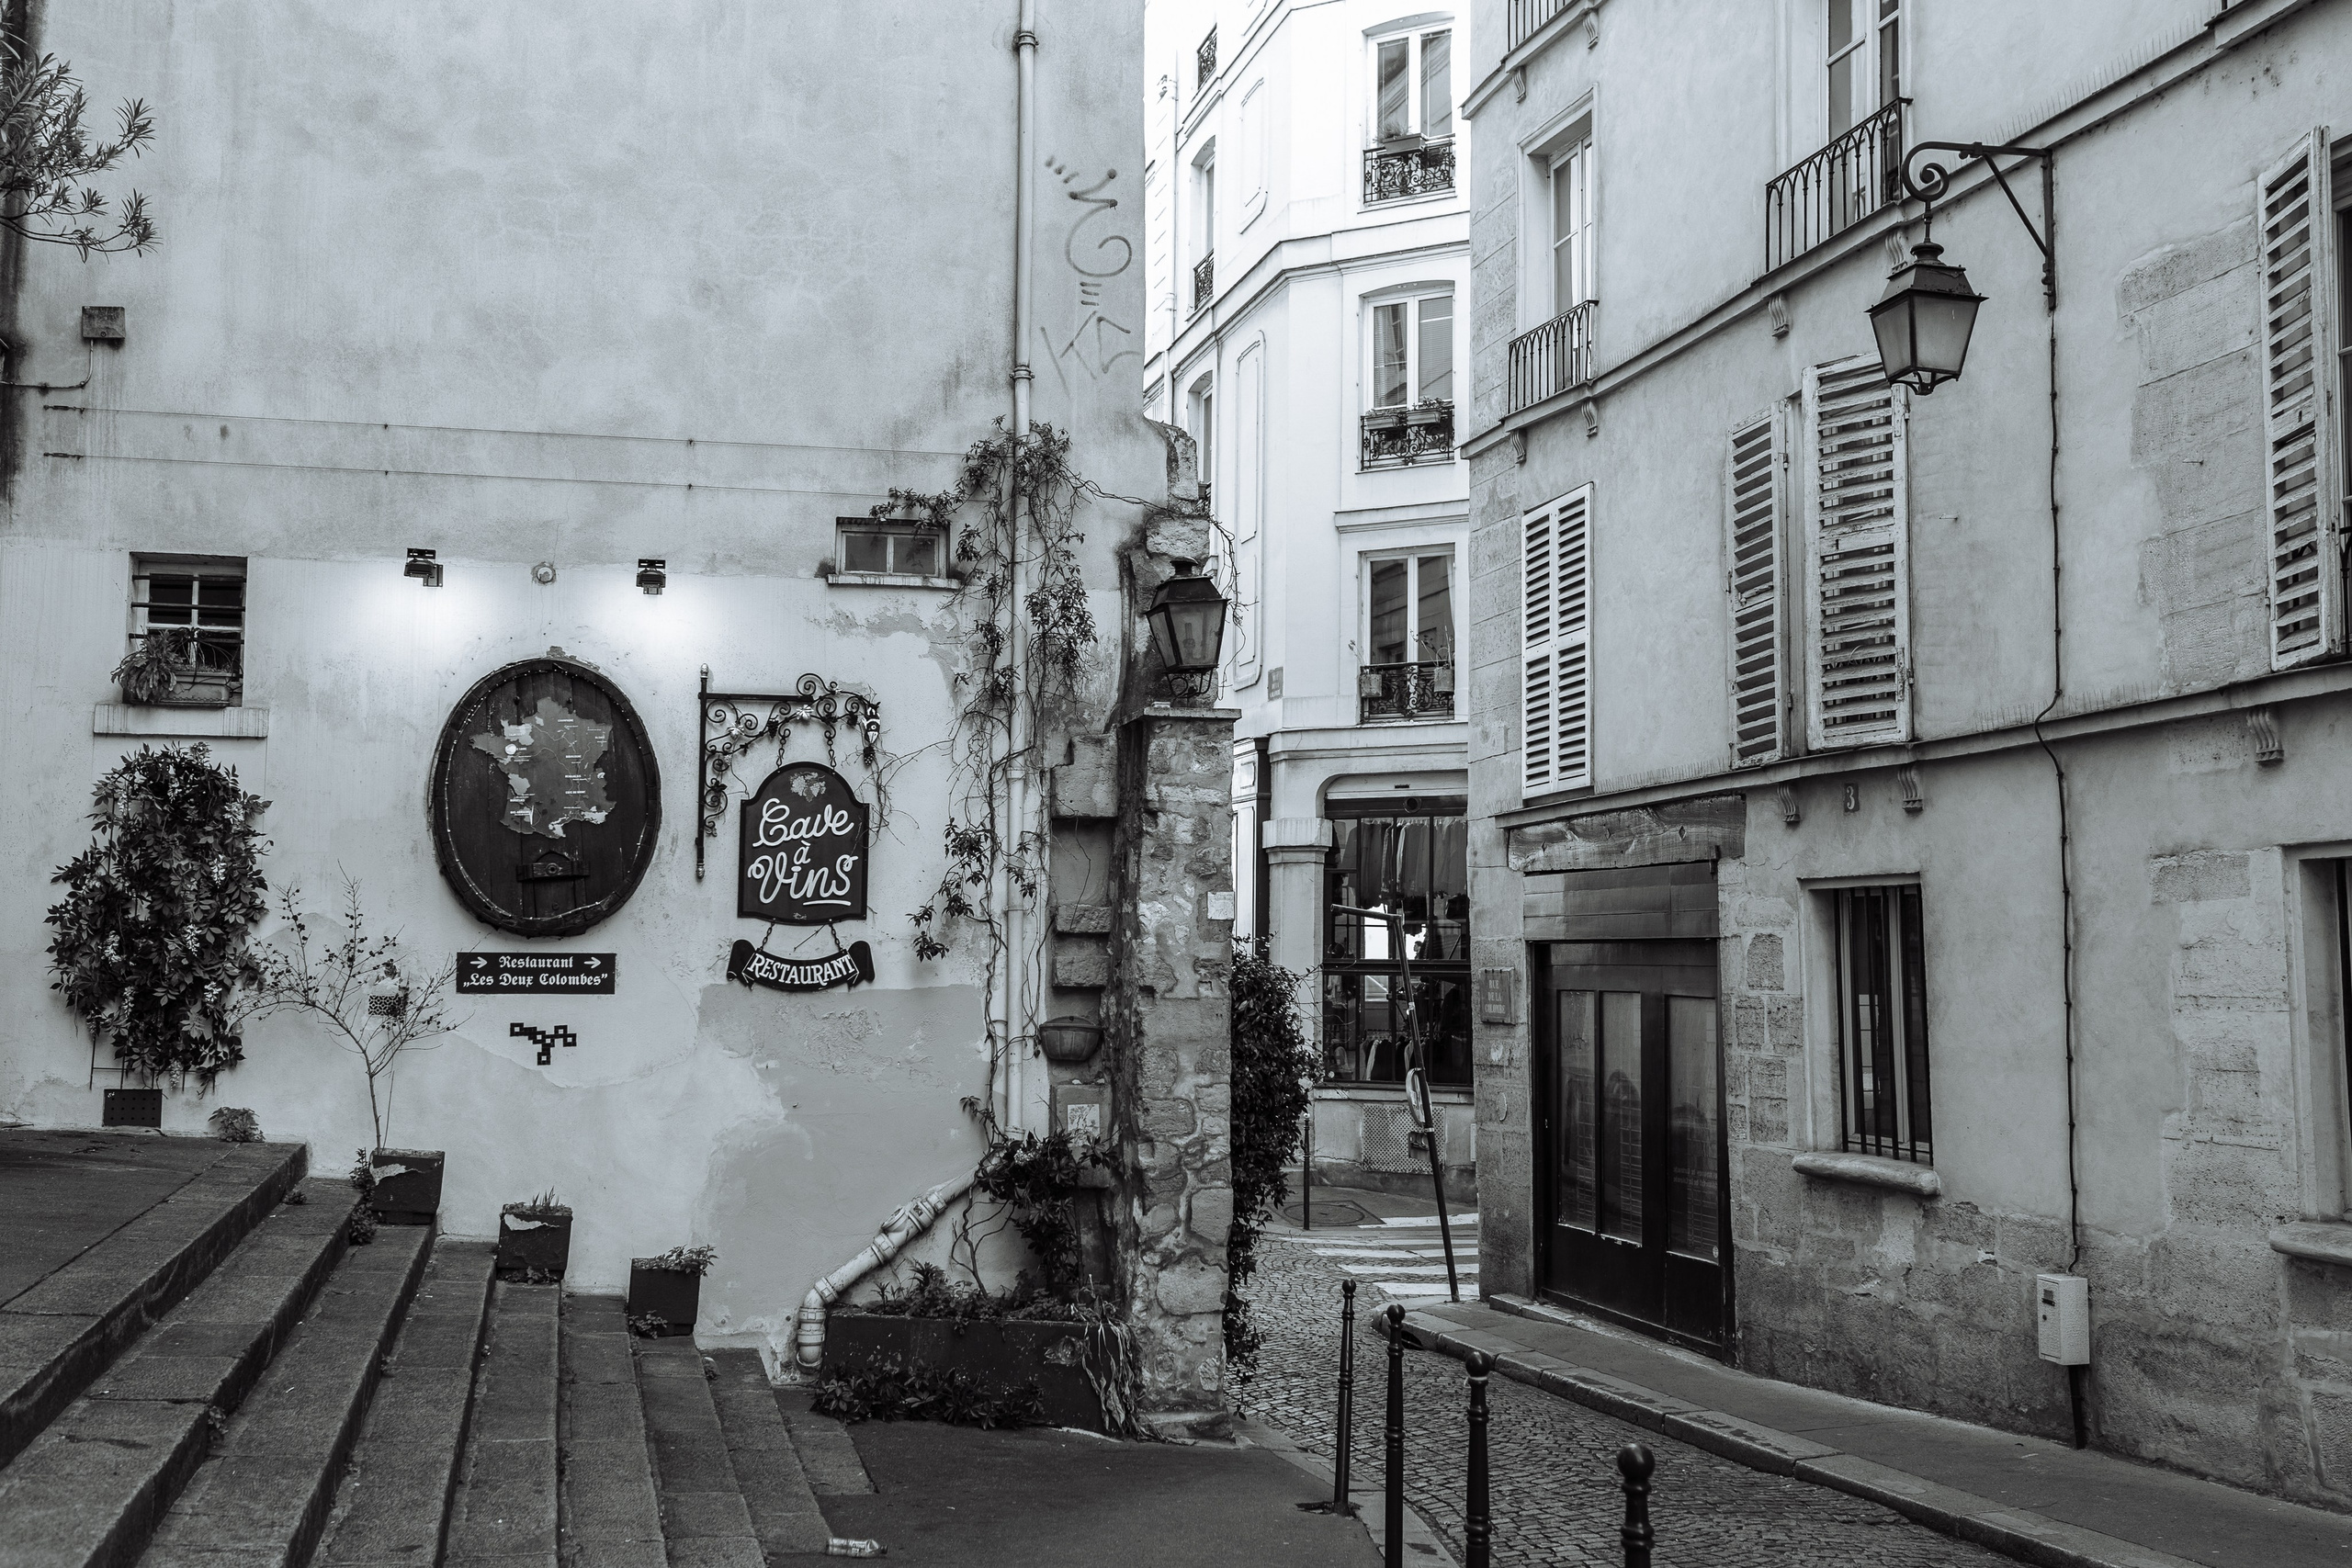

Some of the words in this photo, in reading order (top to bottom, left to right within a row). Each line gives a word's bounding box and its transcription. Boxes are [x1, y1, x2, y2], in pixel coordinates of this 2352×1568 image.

[1847, 785, 1855, 810] 3
[752, 797, 854, 847] Cave
[793, 840, 811, 865] à
[748, 852, 859, 904] Vins
[499, 955, 573, 969] Restaurant
[747, 953, 855, 987] RESTAURANT
[499, 973, 534, 987] Deux
[1488, 979, 1499, 989] RUE
